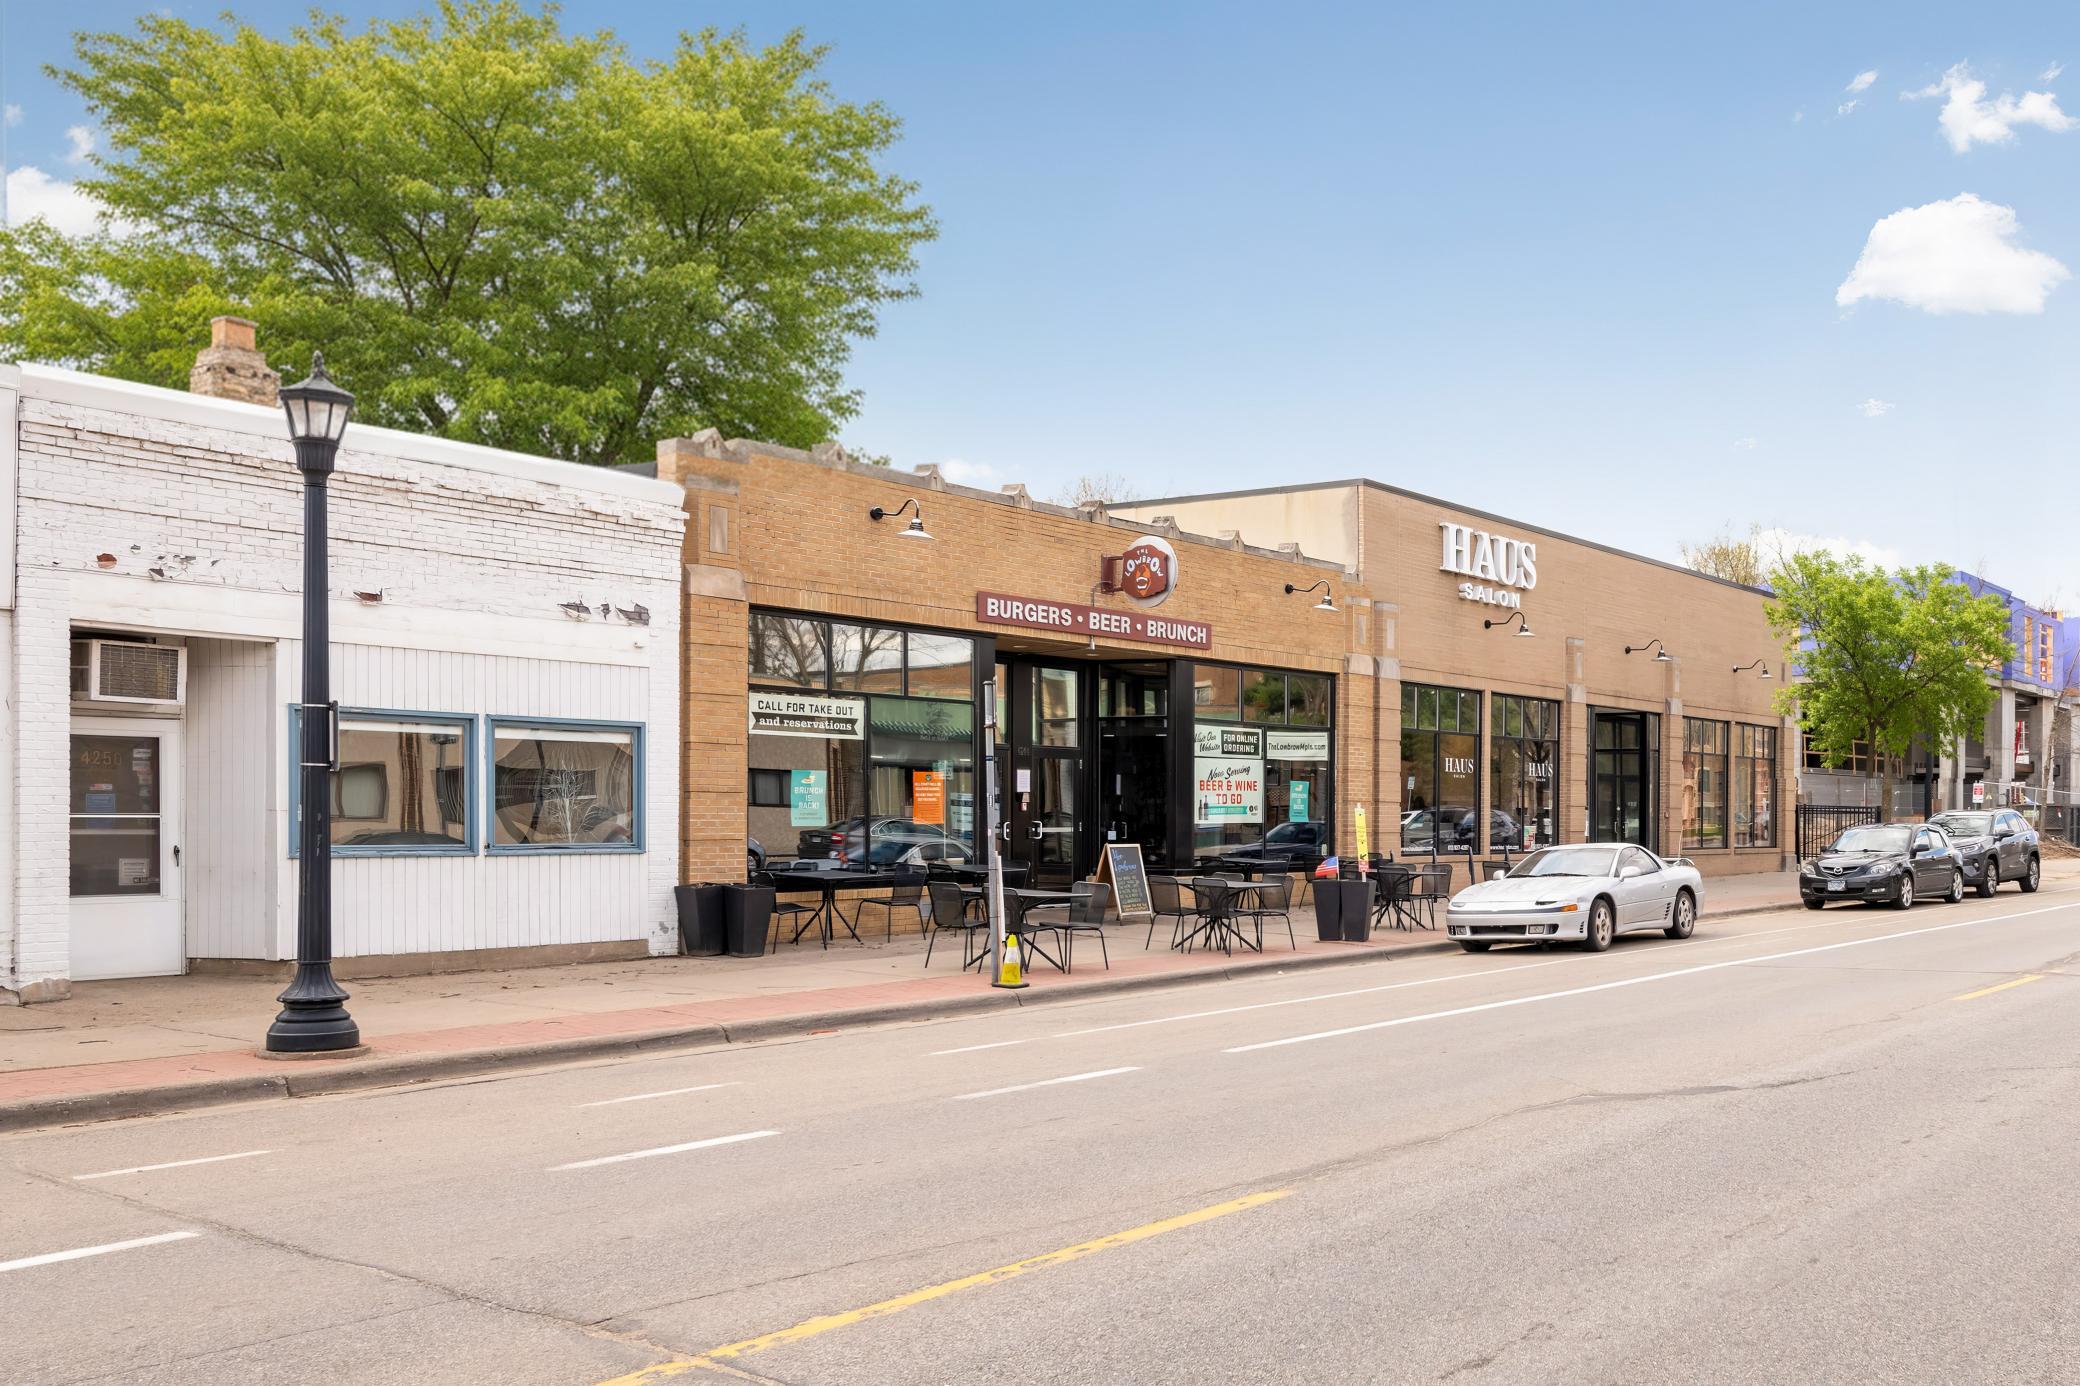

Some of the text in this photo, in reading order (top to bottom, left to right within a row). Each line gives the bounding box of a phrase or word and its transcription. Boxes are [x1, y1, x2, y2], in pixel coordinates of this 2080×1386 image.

[1136, 548, 1149, 556] THE
[1439, 522, 1536, 589] HAUS
[1124, 555, 1164, 577] LOWBROW
[1459, 582, 1520, 608] SALON
[986, 598, 1207, 644] BURGERS BEER BRUNCH
[757, 700, 854, 716] CALL FOR TAKE OUT
[759, 717, 852, 731] and reservations
[1223, 733, 1258, 744] FOR ONLINE
[1223, 743, 1255, 753] ORDERING
[1207, 765, 1251, 781] Now Serving
[1445, 757, 1474, 774] HAUS
[1528, 762, 1554, 777] HAUS
[1199, 780, 1258, 791] BEER & WINE
[805, 794, 812, 802] IS
[1216, 793, 1242, 805] TO GO
